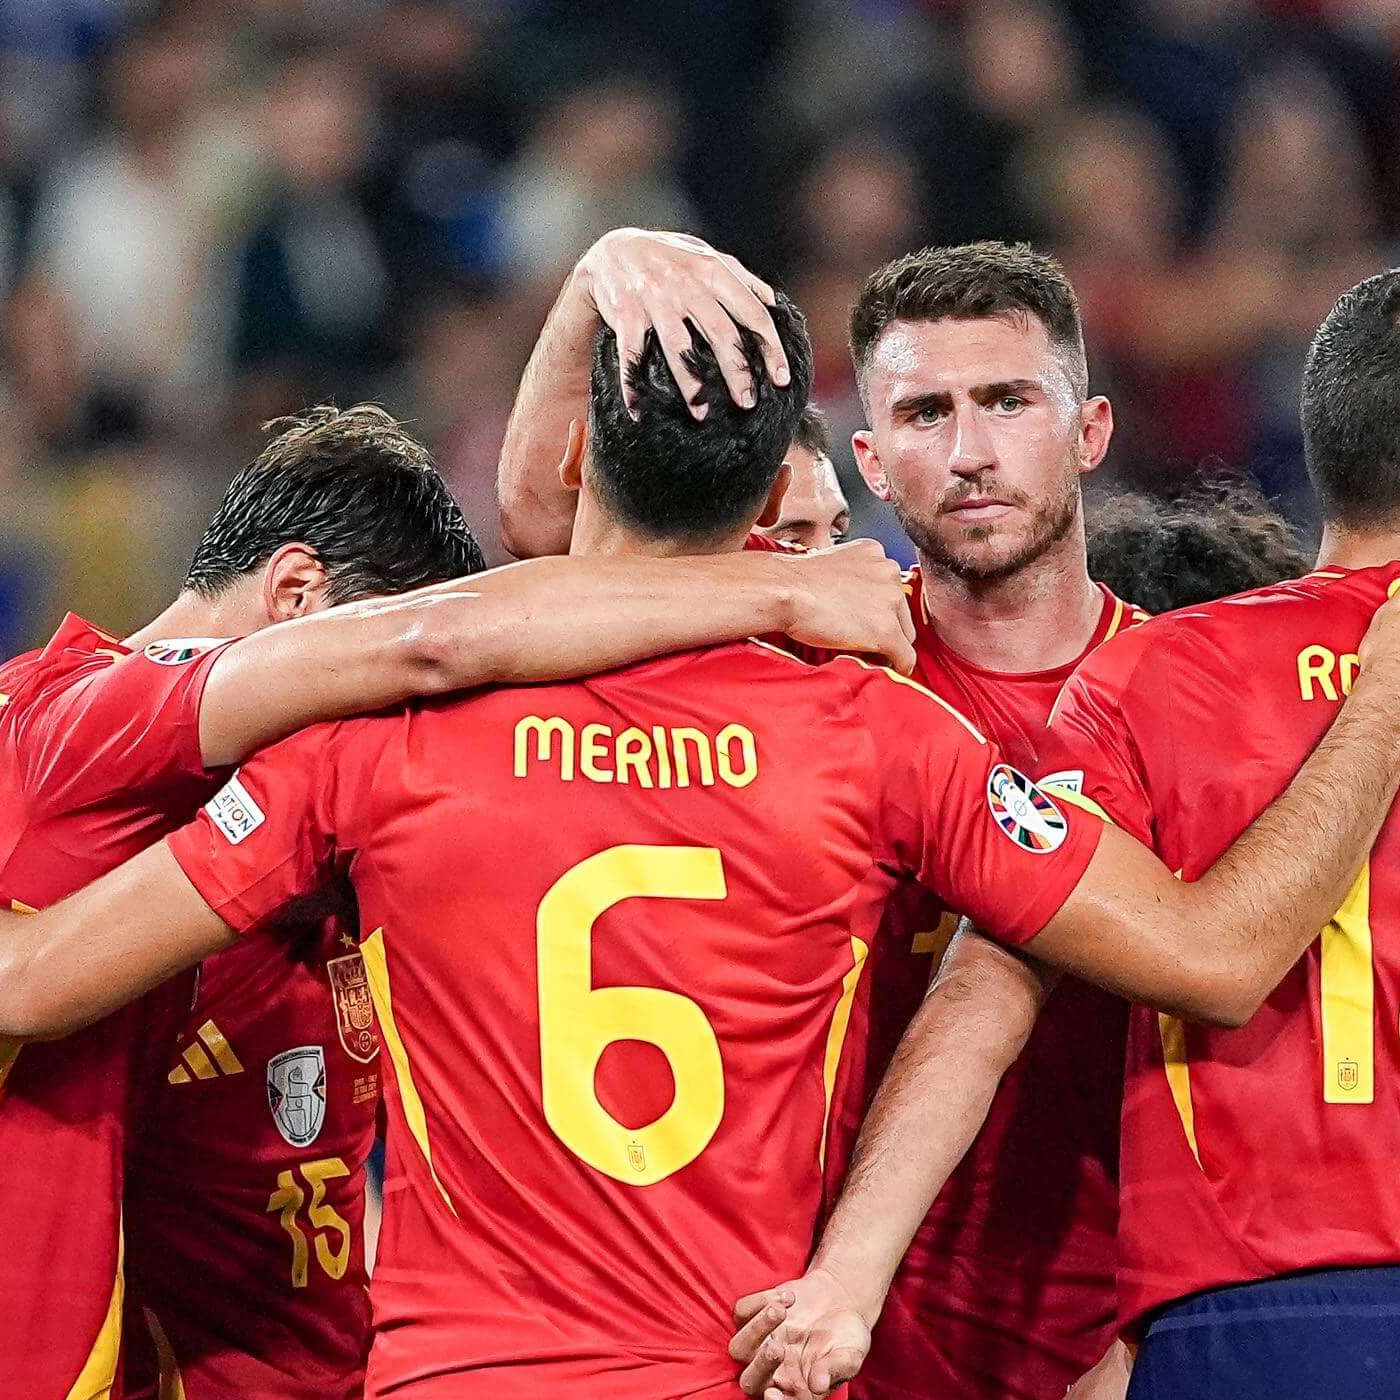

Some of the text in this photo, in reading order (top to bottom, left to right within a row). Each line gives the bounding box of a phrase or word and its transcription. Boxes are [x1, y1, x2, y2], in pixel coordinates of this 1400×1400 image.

[513, 715, 758, 789] MERINO
[536, 844, 728, 1187] 6
[266, 1157, 351, 1288] 15
